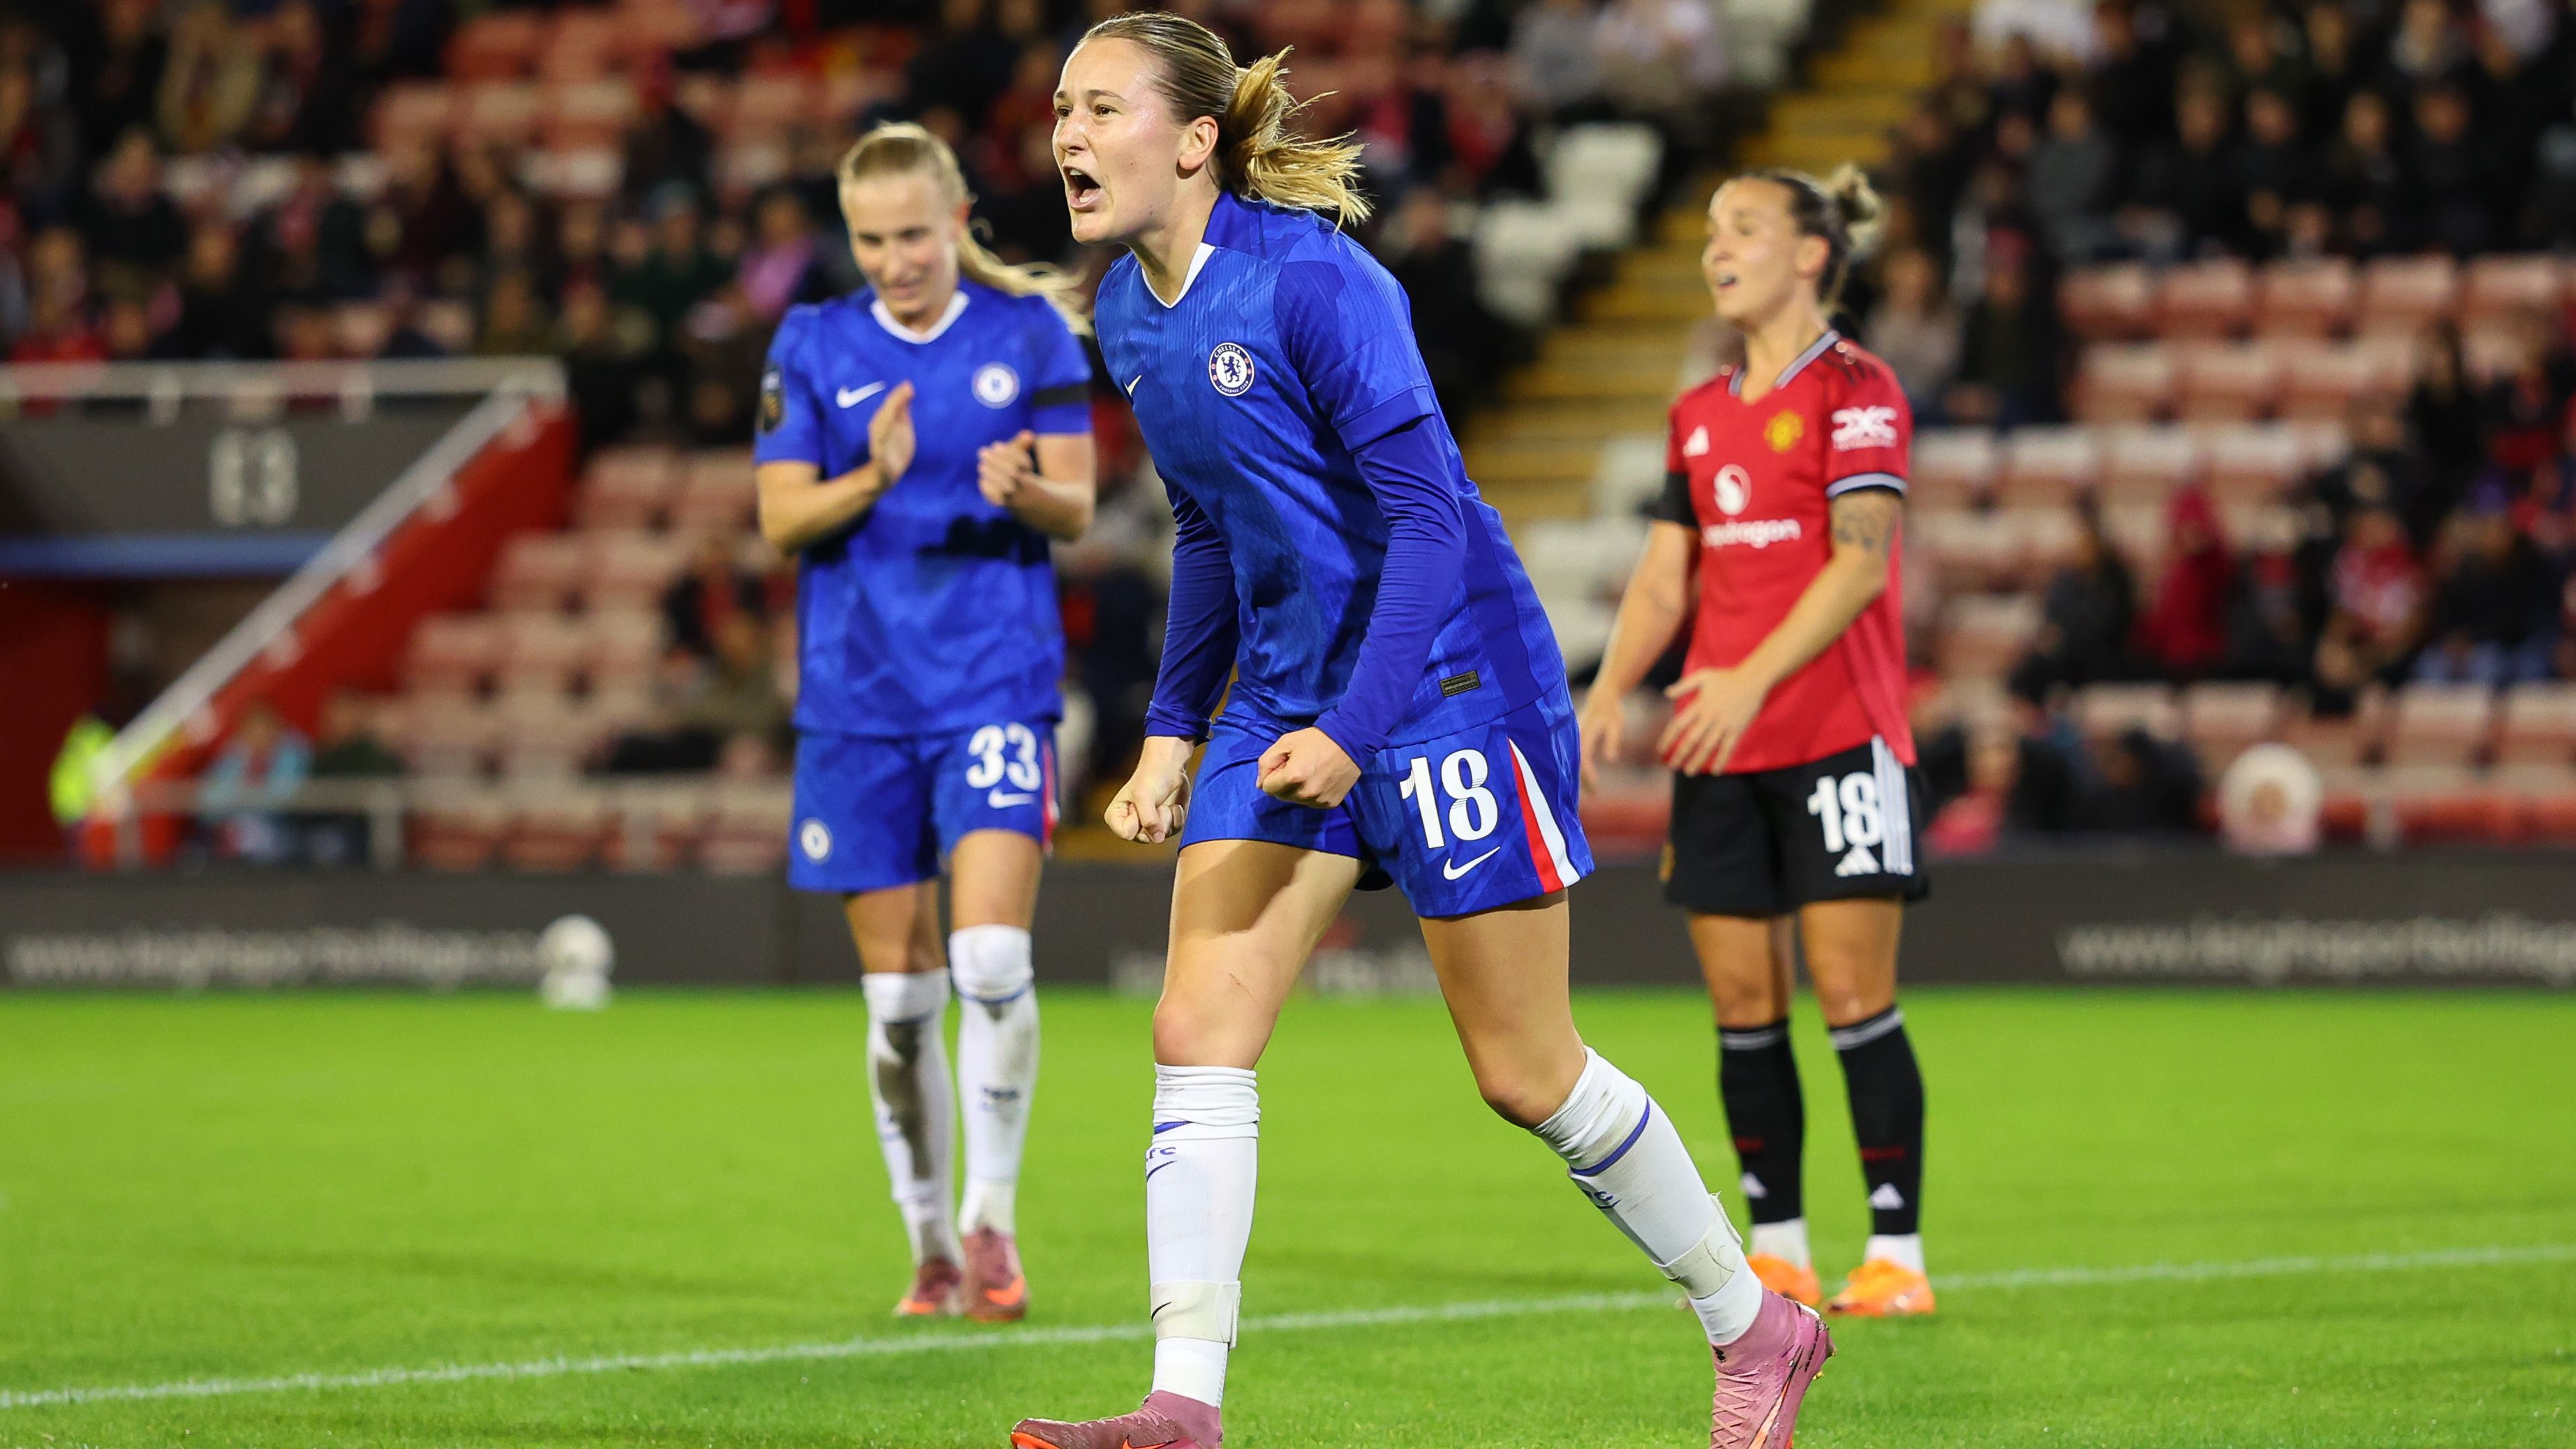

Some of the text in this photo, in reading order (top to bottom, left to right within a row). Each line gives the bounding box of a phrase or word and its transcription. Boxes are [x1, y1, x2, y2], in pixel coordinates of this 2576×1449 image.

[1214, 345, 1241, 358] CHELSEA
[965, 722, 1041, 793] 33
[1399, 748, 1499, 849] 18
[1807, 771, 1883, 854] 18
